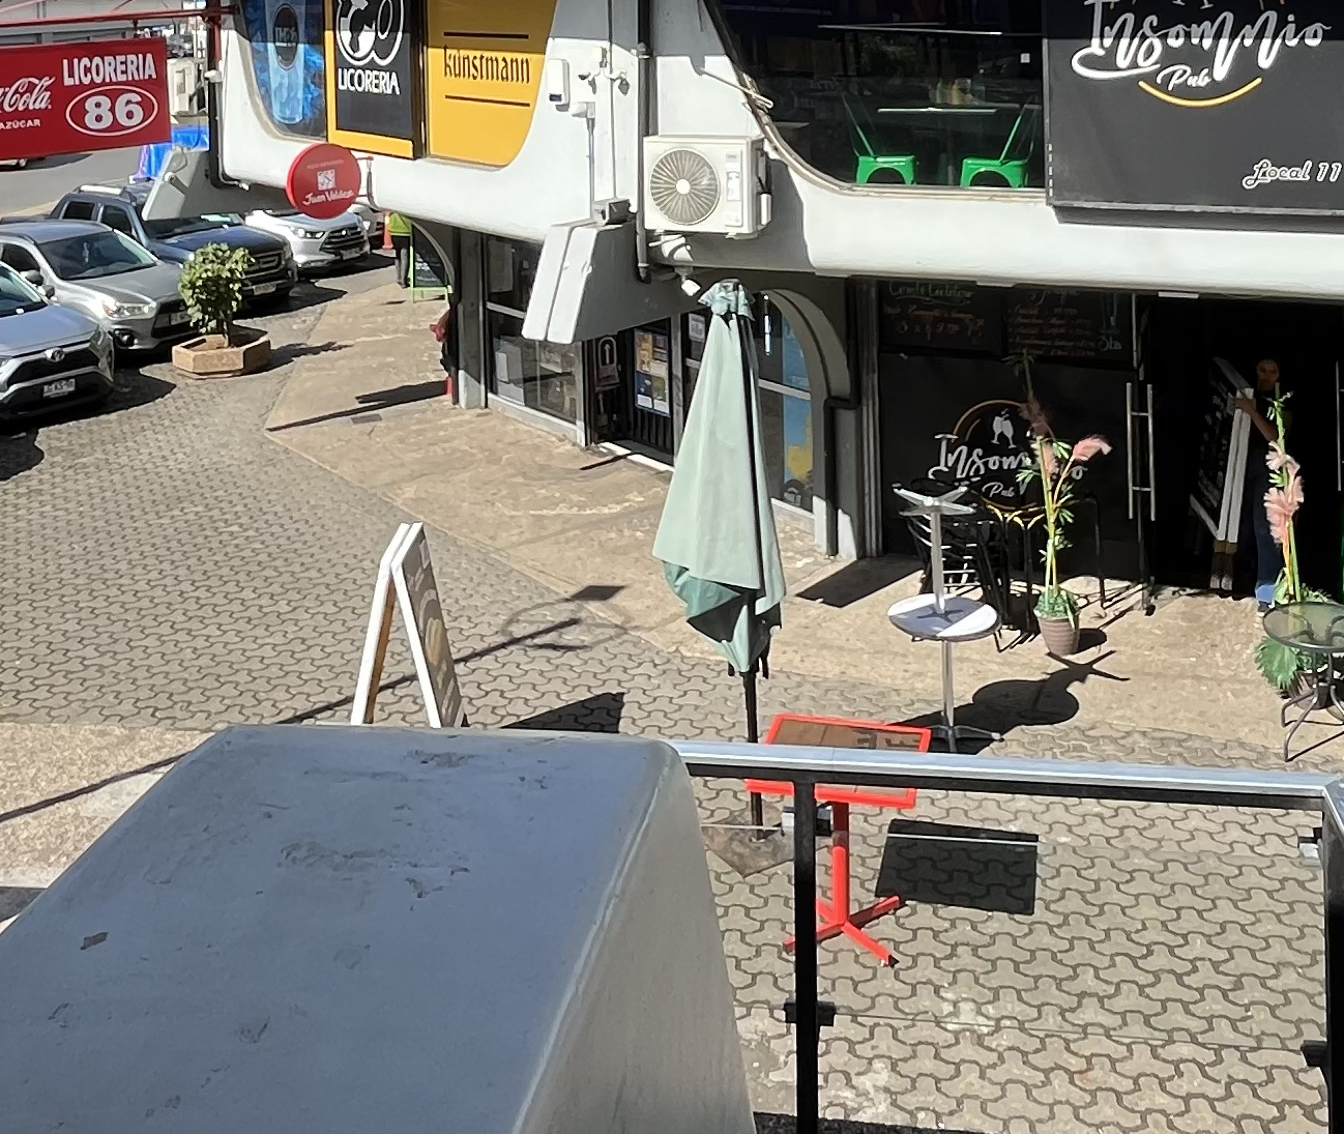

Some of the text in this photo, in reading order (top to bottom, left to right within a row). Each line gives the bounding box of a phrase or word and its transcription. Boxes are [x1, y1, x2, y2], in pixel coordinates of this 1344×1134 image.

[62, 54, 157, 87] LICORERIA
[338, 68, 400, 95] LICORERIA
[1156, 65, 1211, 91] Pub
[84, 92, 144, 130] 86
[1242, 159, 1342, 190] Local 11
